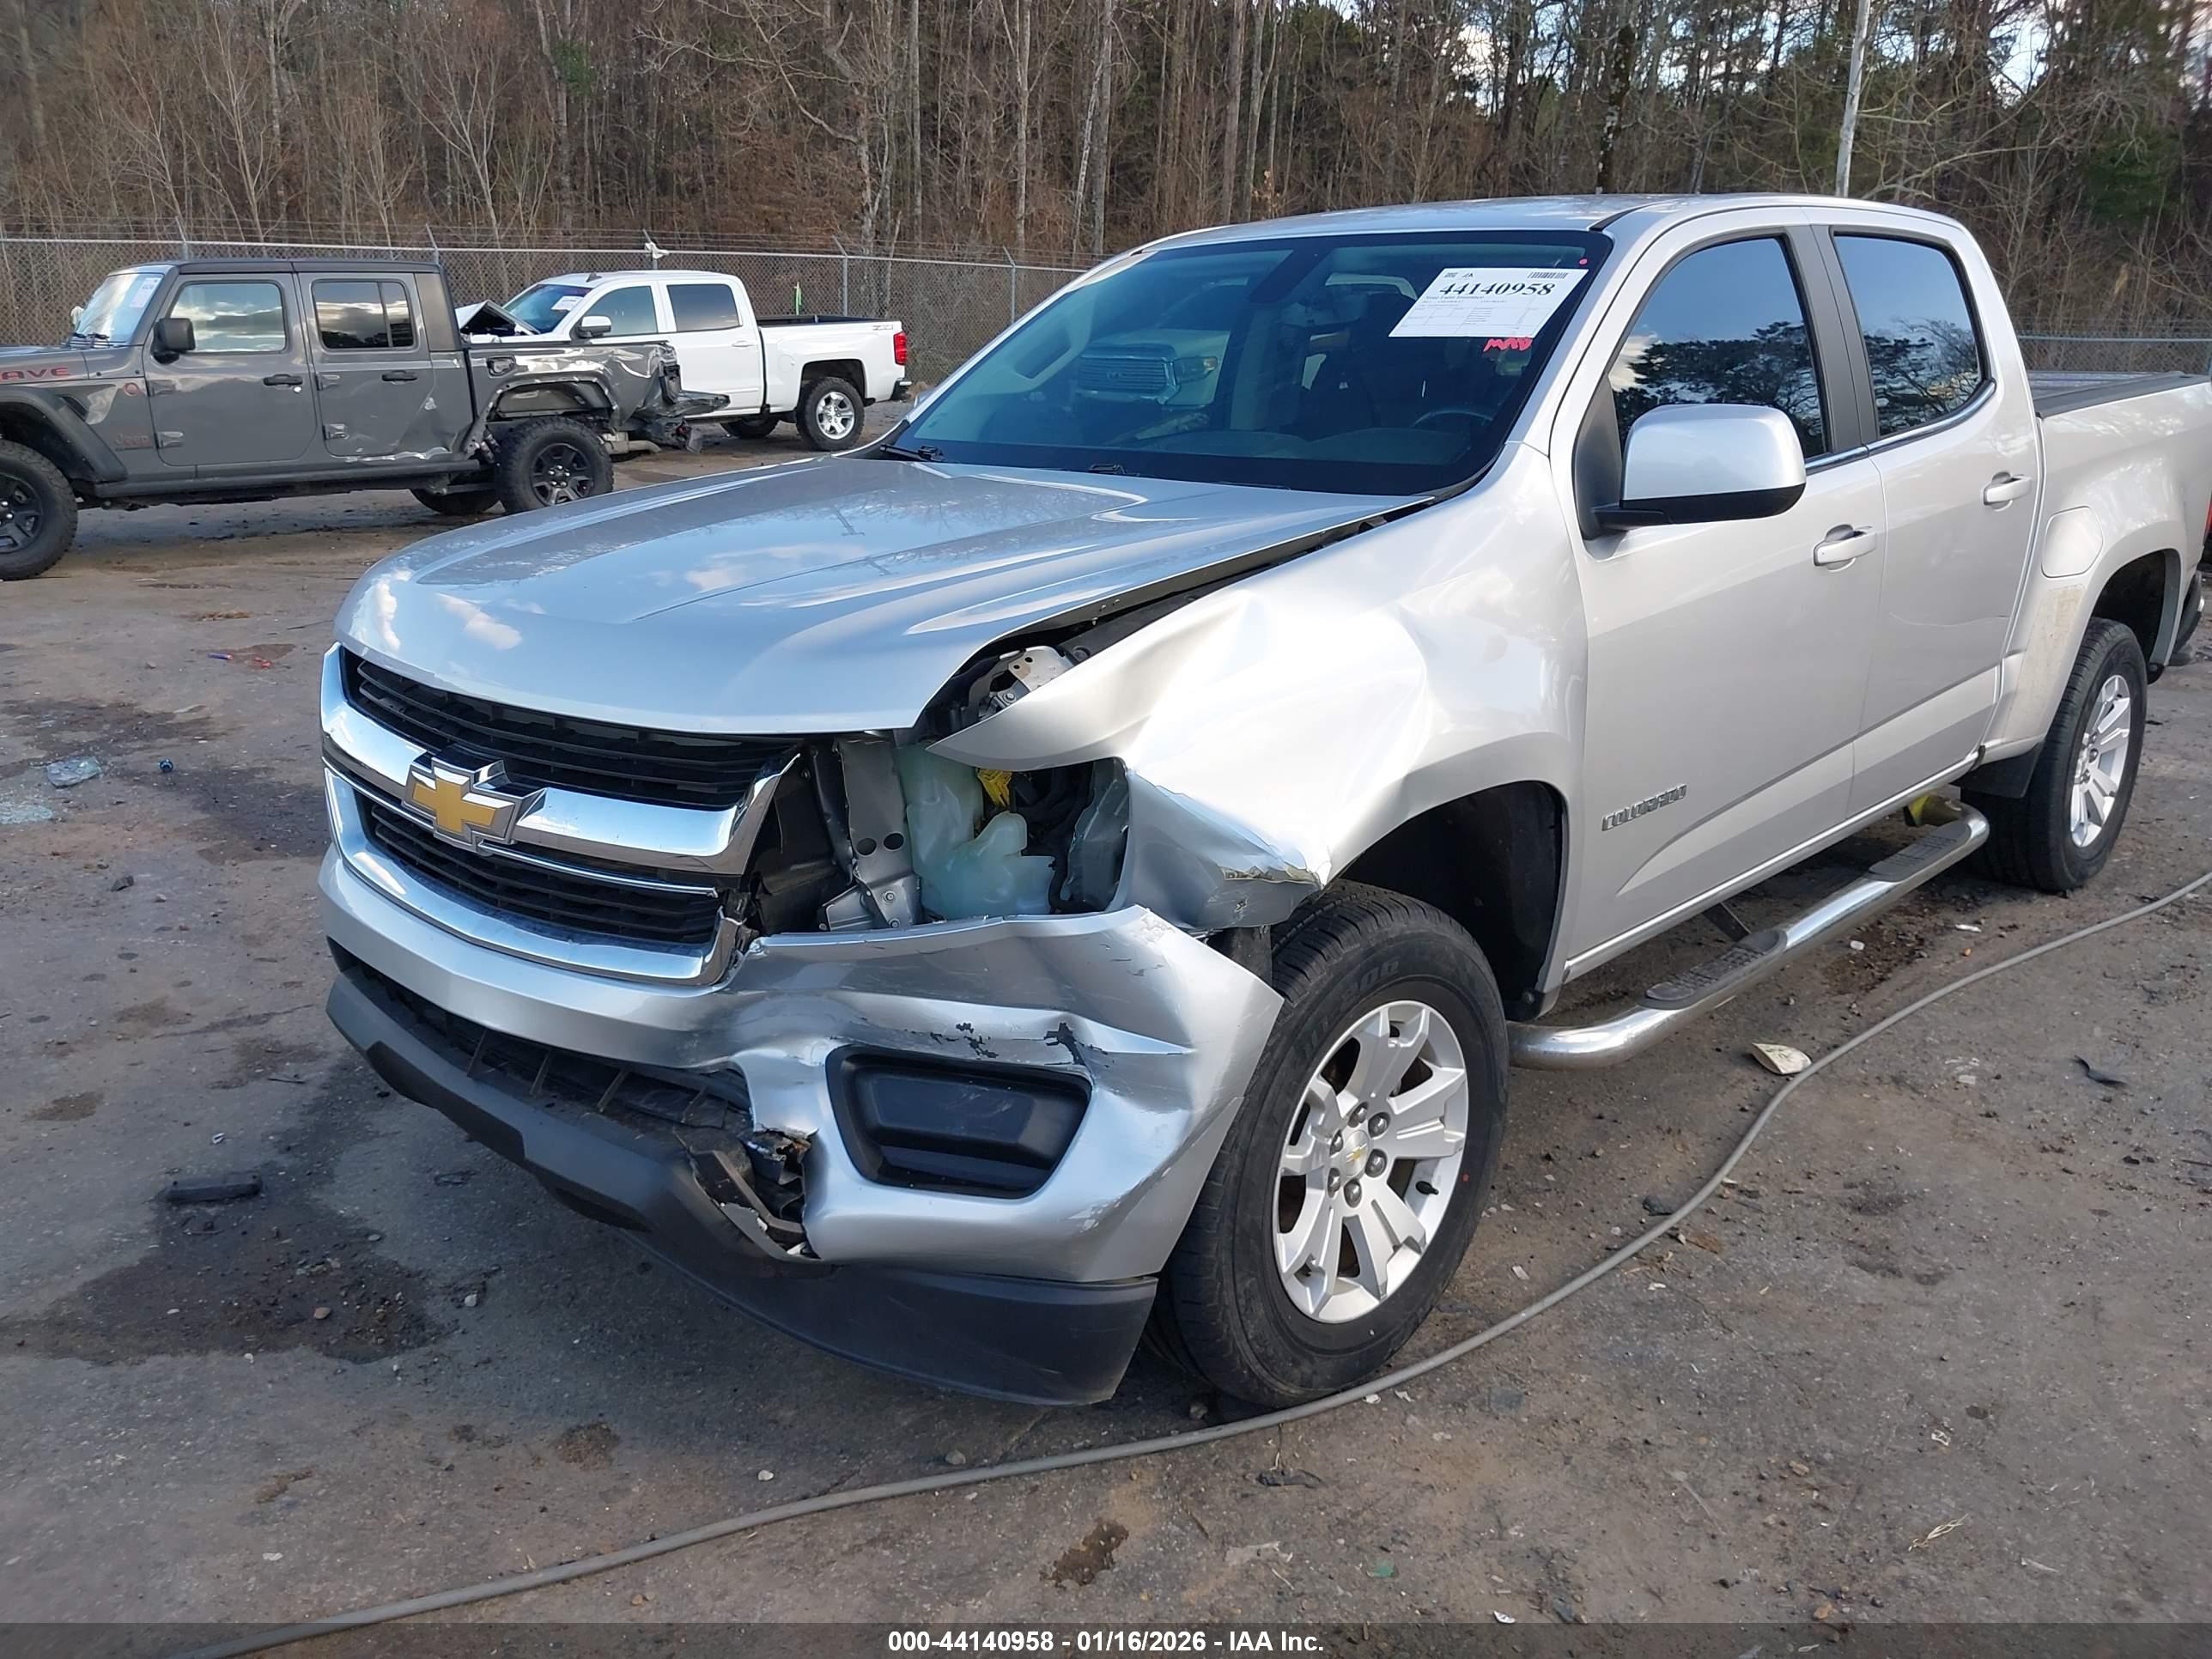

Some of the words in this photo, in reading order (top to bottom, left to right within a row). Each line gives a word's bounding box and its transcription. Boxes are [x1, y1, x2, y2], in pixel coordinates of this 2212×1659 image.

[1439, 282, 1556, 296] 44140958
[0, 367, 70, 381] AVE
[1601, 783, 1688, 831] COLORADO
